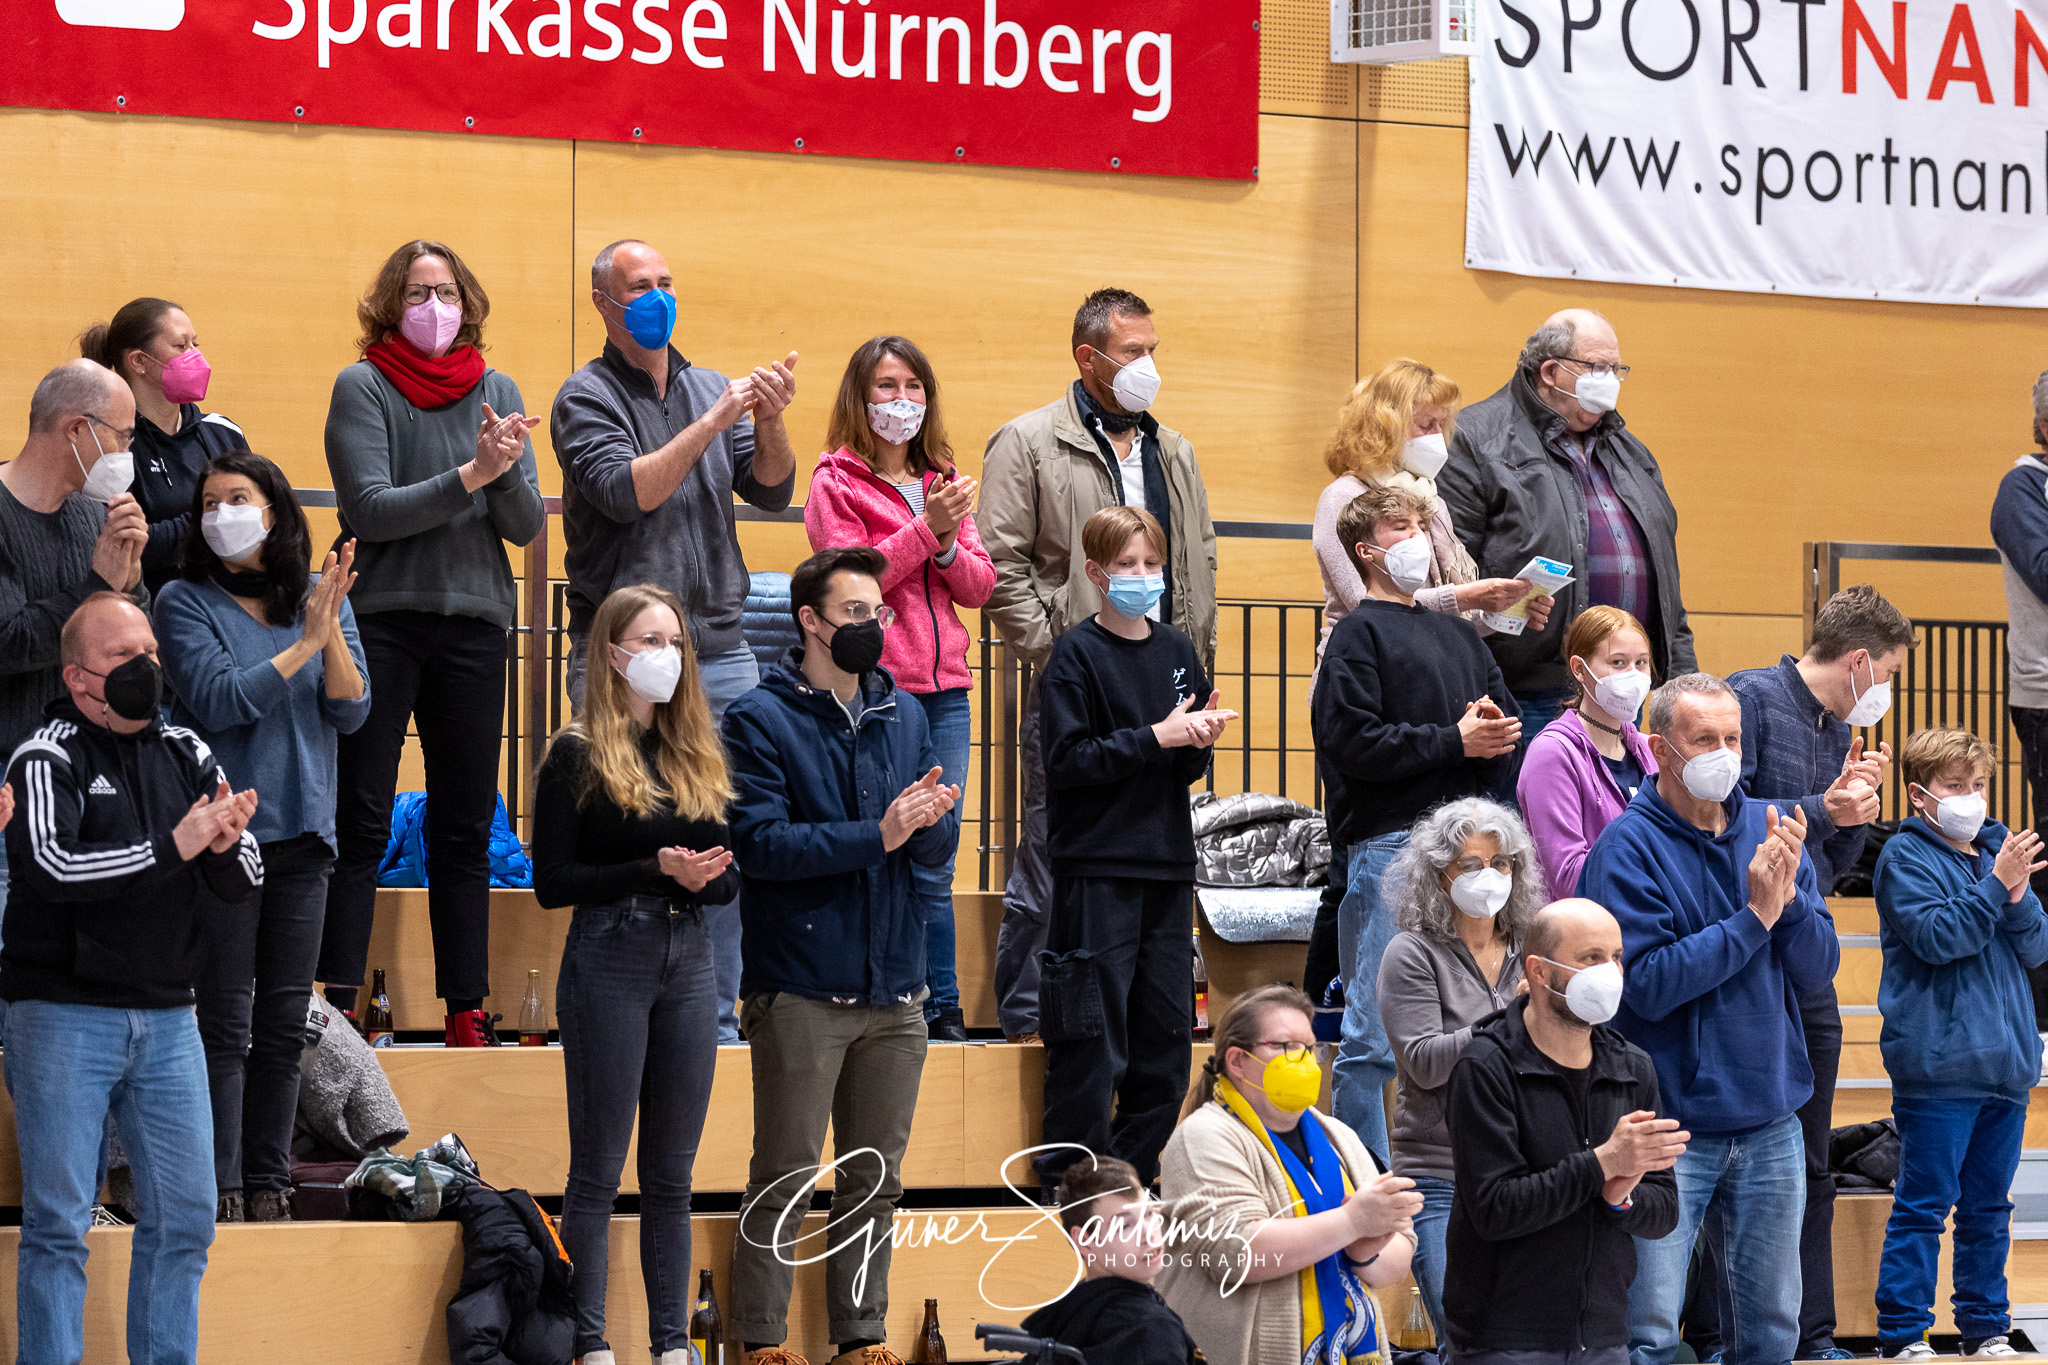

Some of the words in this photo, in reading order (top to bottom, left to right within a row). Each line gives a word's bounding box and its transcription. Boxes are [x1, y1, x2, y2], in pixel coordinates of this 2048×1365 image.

[763, 0, 1172, 123] Nürnberg
[1493, 122, 2048, 226] www.sportnan
[88, 787, 118, 795] adidas
